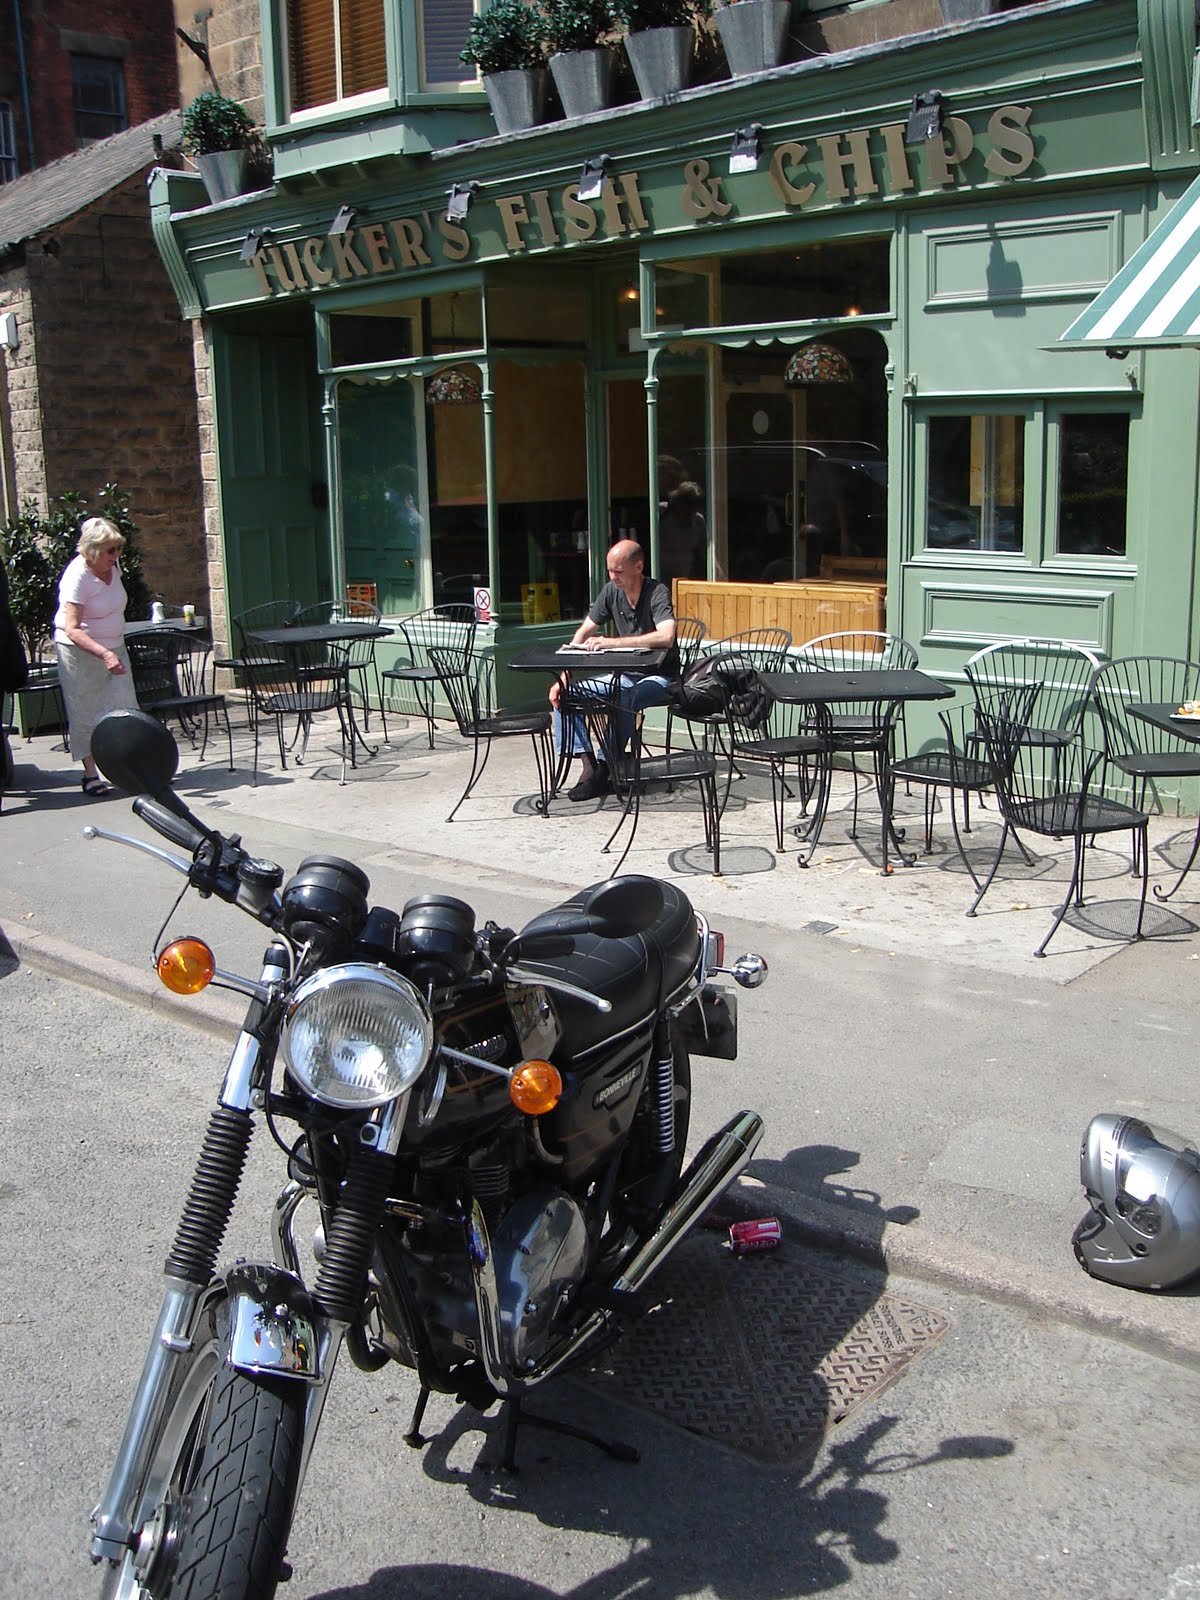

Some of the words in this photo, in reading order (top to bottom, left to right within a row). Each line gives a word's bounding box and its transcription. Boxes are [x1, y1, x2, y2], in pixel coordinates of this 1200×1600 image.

[246, 210, 470, 295] TUCKER'S
[495, 172, 649, 250] FISH
[680, 159, 732, 219] &
[768, 105, 1034, 205] CHIPS
